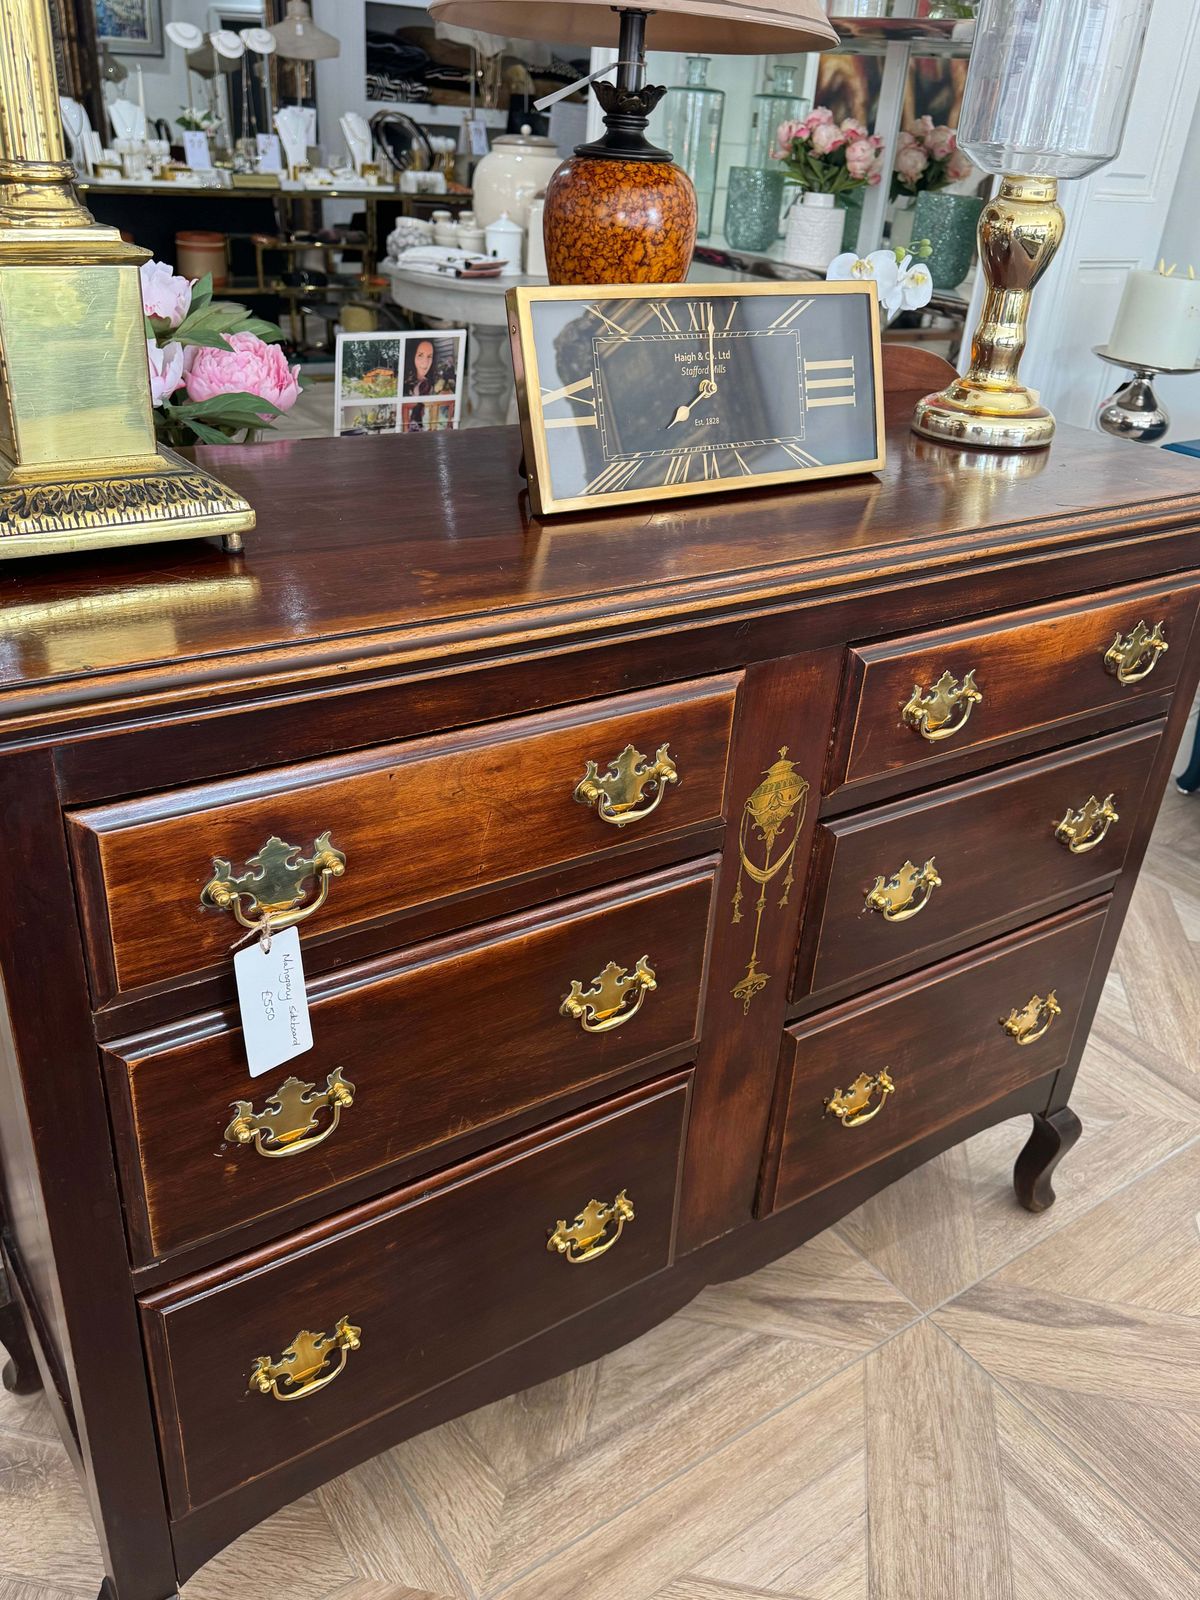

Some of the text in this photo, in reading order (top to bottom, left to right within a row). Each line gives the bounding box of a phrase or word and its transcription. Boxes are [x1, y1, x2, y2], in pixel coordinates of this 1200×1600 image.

[674, 352, 697, 364] Haigh
[697, 351, 703, 361] &
[718, 350, 731, 360] Ltd
[681, 365, 709, 377] Stafford
[706, 417, 720, 425] 1828
[261, 990, 275, 1021] £550
